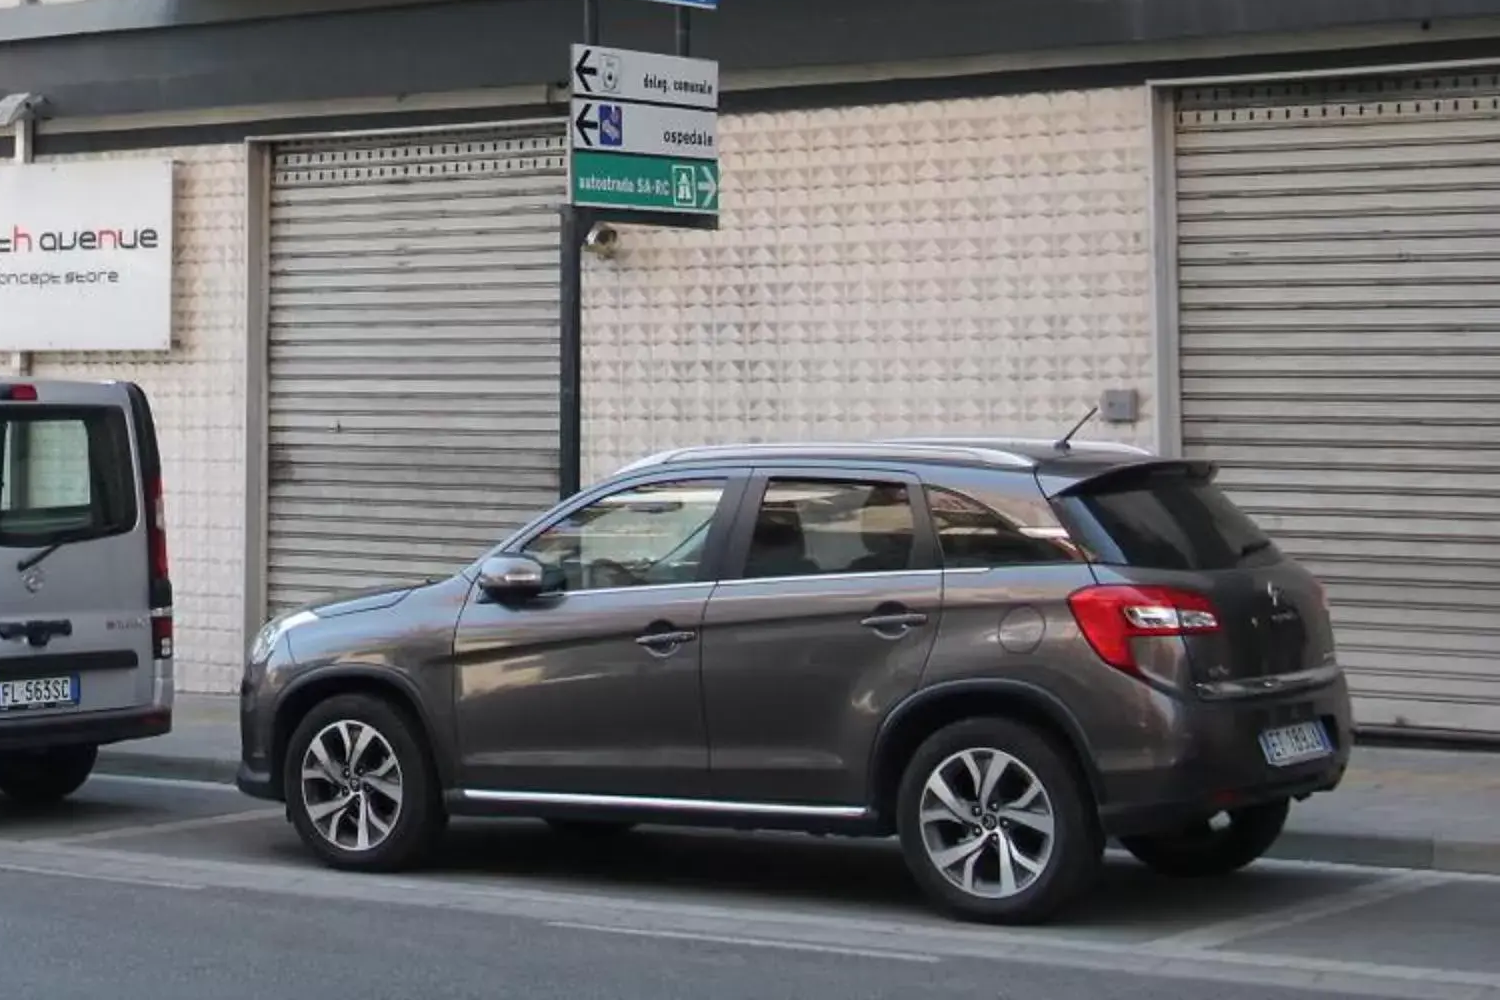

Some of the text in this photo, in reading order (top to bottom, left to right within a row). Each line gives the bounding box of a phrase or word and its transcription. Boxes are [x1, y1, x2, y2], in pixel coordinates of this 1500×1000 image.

[643, 73, 713, 95] deleg. comunale
[663, 129, 713, 147] ospedale
[579, 175, 671, 197] autostrada SA-RC
[39, 227, 159, 253] avenue
[64, 270, 119, 285] store
